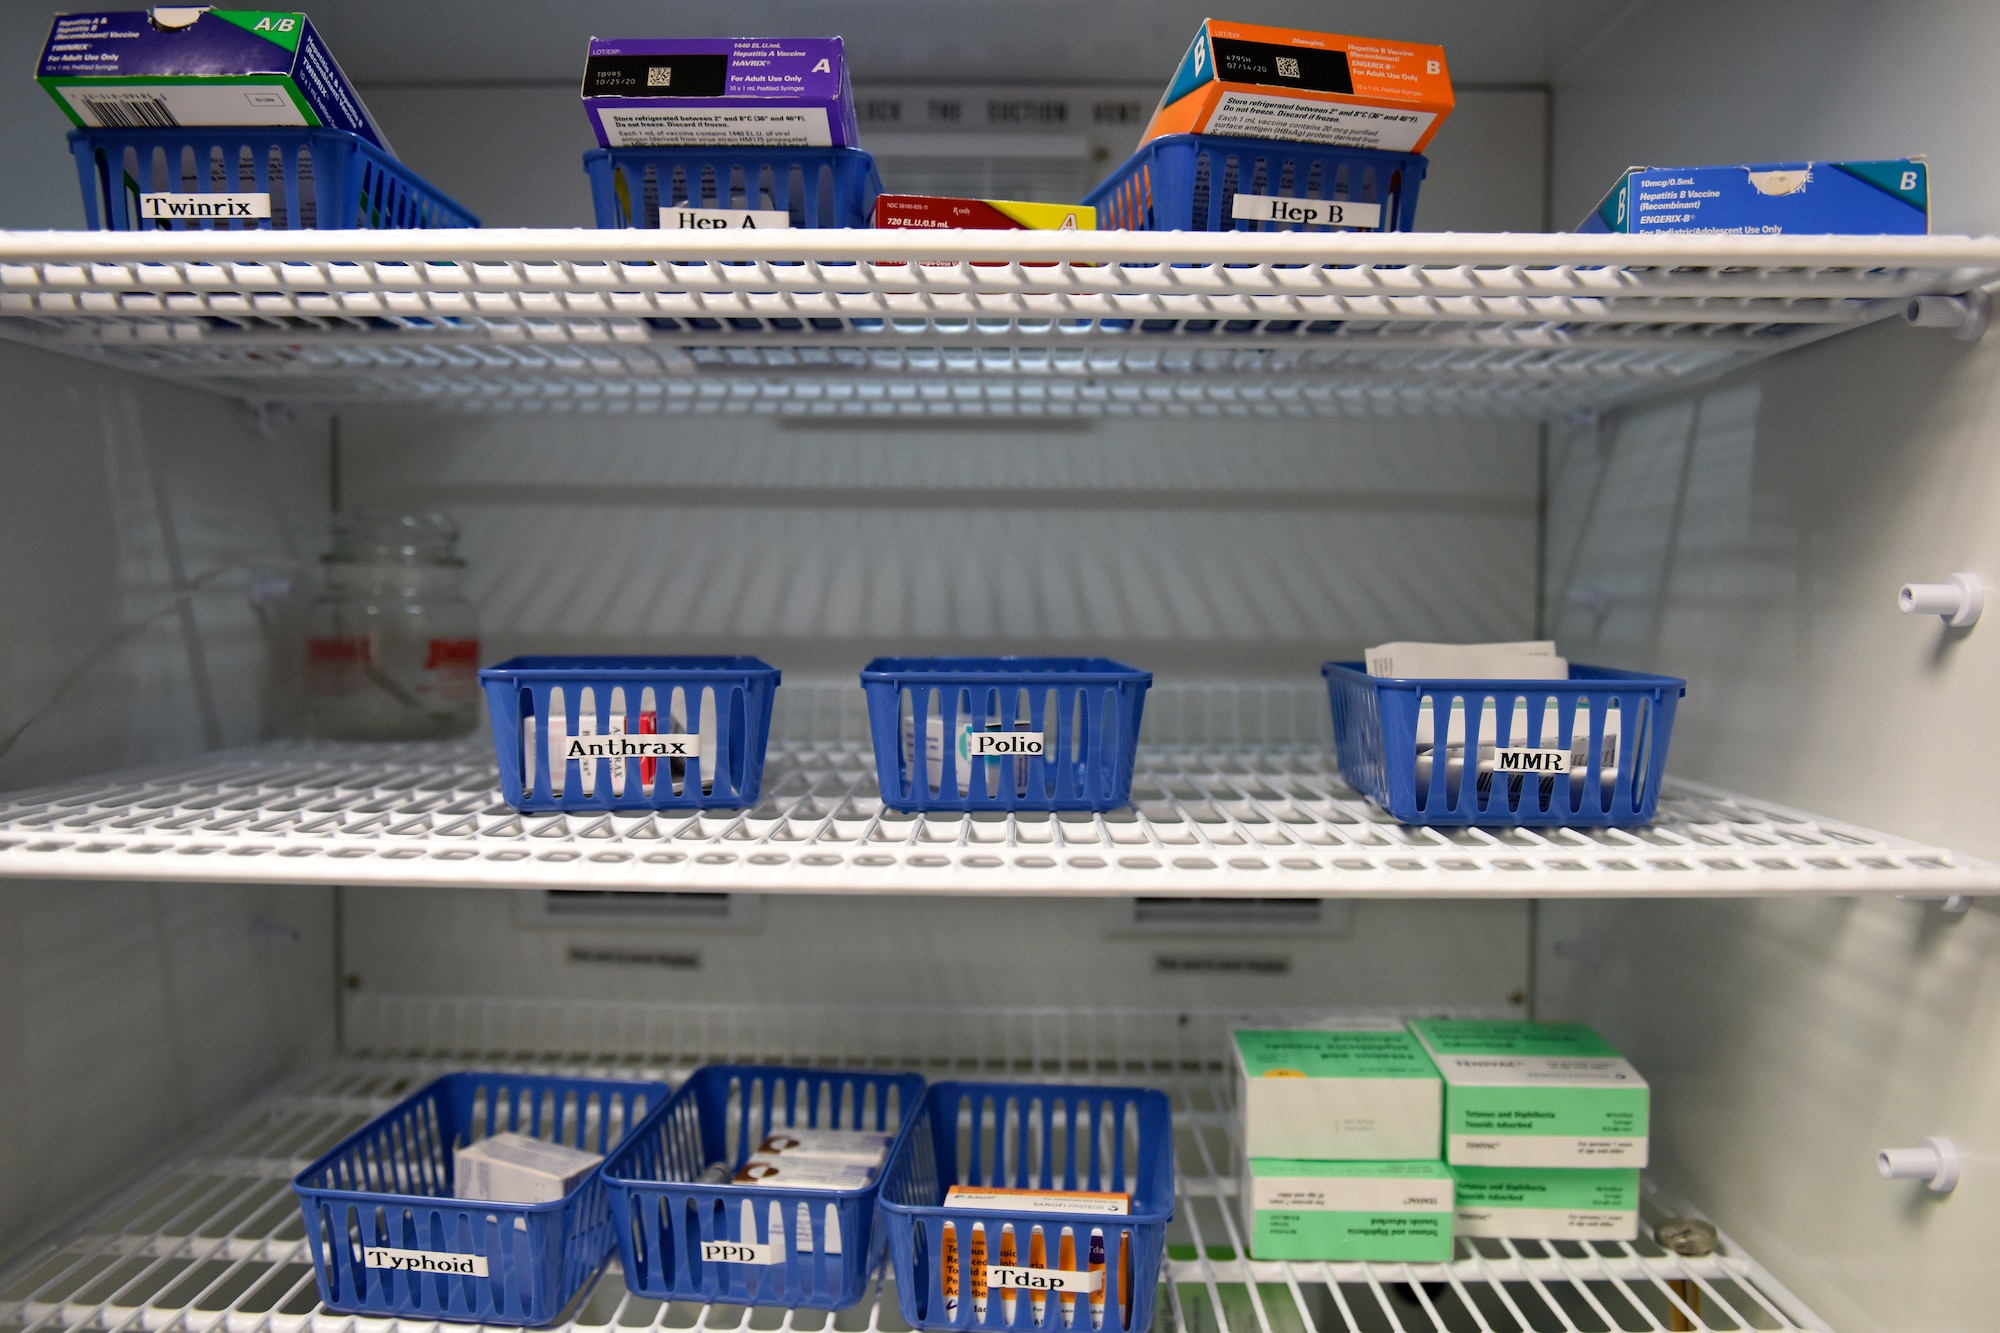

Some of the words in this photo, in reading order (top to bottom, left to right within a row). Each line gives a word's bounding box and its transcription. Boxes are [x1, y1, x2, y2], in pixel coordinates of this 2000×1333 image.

[254, 17, 296, 32] A/B
[1292, 38, 1325, 47] 20mcg/mL
[1348, 44, 1379, 53] Hepatitis
[101, 54, 119, 62] Only
[1194, 35, 1205, 78] B
[1350, 52, 1400, 63] (Recombinant)
[811, 59, 830, 73] A
[1226, 62, 1267, 72] 07/14/20
[1427, 60, 1440, 74] B
[1402, 74, 1418, 82] Only
[1249, 100, 1294, 110] refrigerated
[1295, 104, 1328, 114] between
[1249, 108, 1275, 116] freeze.
[1277, 110, 1308, 119] Discard
[1316, 114, 1340, 122] frozen.
[1258, 119, 1288, 127] vaccine
[1289, 122, 1321, 130] contains
[1274, 127, 1306, 137] (HBsAg)
[1306, 131, 1333, 139] protein
[1641, 178, 1694, 188] 10mcg/0.5mL
[1900, 171, 1918, 190] B
[1640, 192, 1678, 201] Hepatitis
[1688, 190, 1720, 198] Vaccine
[146, 198, 252, 216] Twinrix
[1270, 201, 1317, 223] Hep
[1328, 205, 1343, 223] B
[1617, 187, 1626, 225] B
[1640, 200, 1700, 211] (Recombinant)
[679, 212, 727, 229] Hep
[742, 214, 756, 229] A
[1058, 213, 1078, 231] A
[1762, 225, 1782, 234] Only
[568, 739, 687, 756] Anthrax
[978, 736, 1042, 753] Polio
[1499, 752, 1565, 771] MMR
[705, 1245, 756, 1262] PPD
[368, 1251, 474, 1273] Typhoid
[994, 1269, 1064, 1291] Tdap
